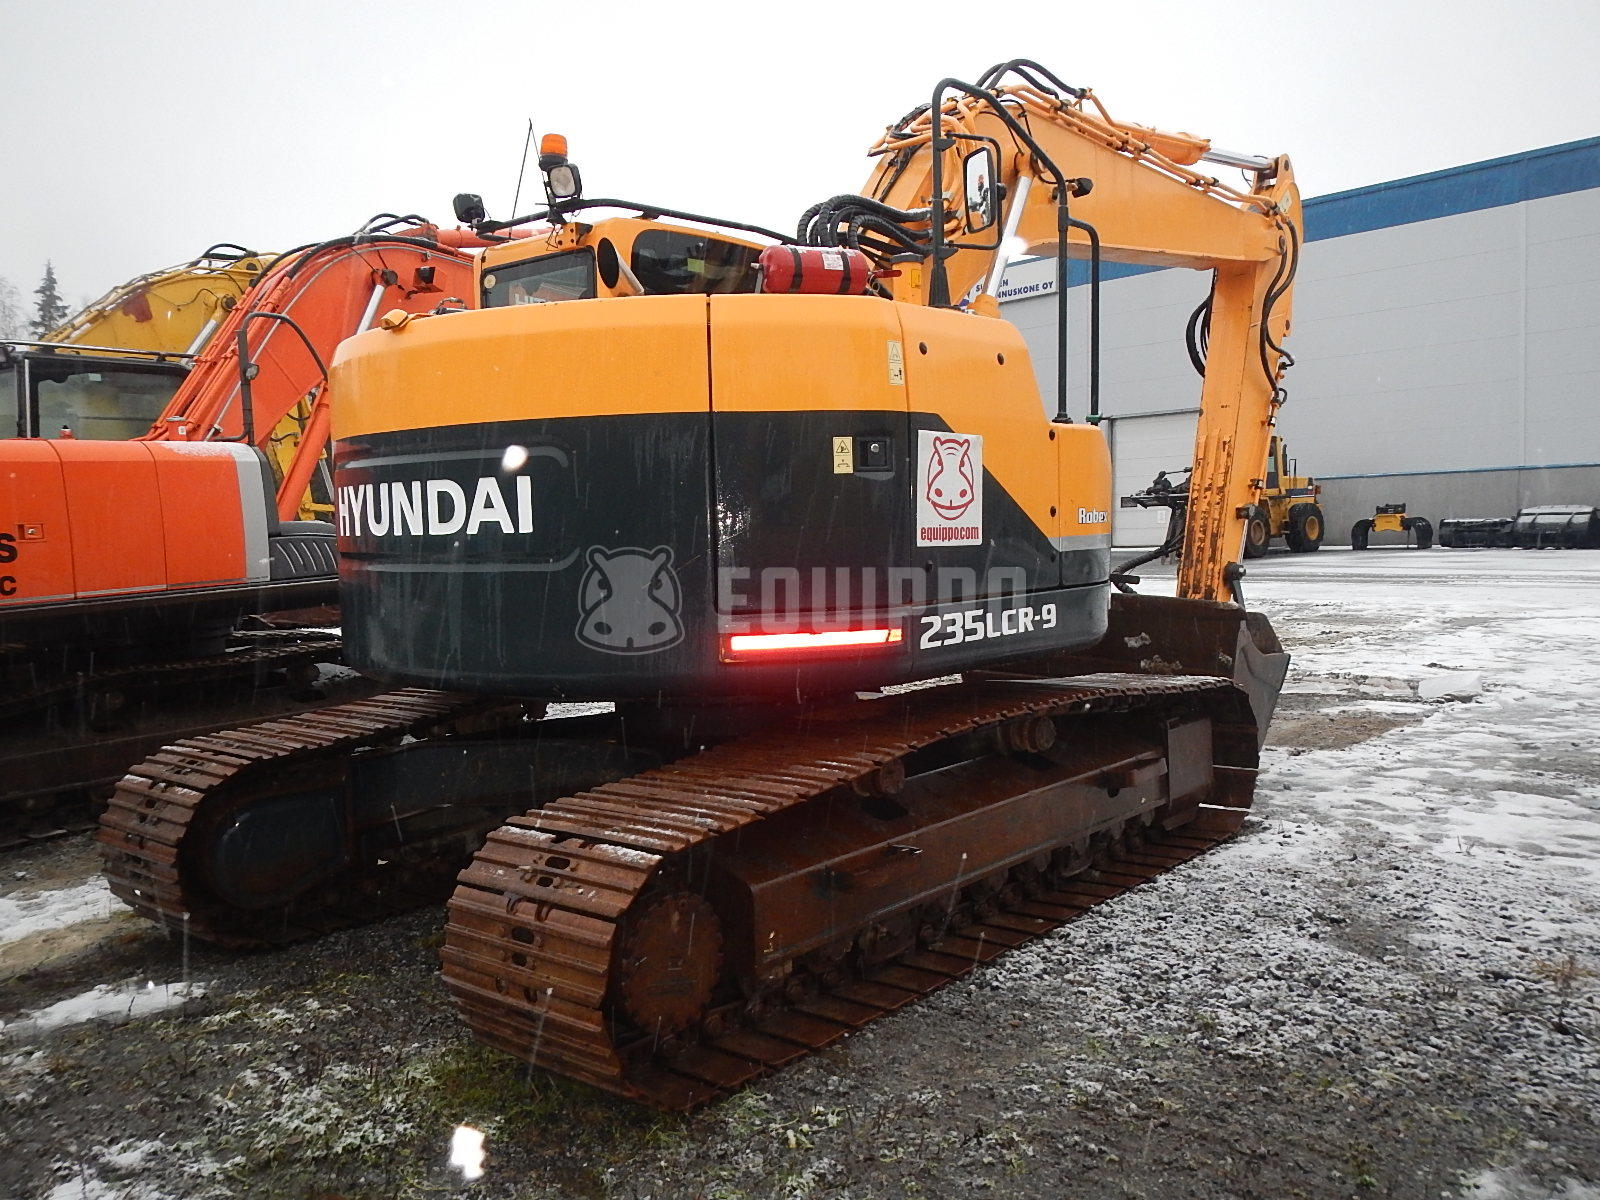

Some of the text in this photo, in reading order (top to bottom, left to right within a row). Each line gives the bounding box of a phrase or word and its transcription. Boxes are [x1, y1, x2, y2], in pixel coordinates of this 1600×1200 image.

[1042, 280, 1054, 289] OY
[338, 475, 534, 537] HYUNDAI
[1078, 507, 1108, 524] Robex
[920, 524, 980, 542] equippo.com
[919, 603, 1057, 650] 235LCR-9
